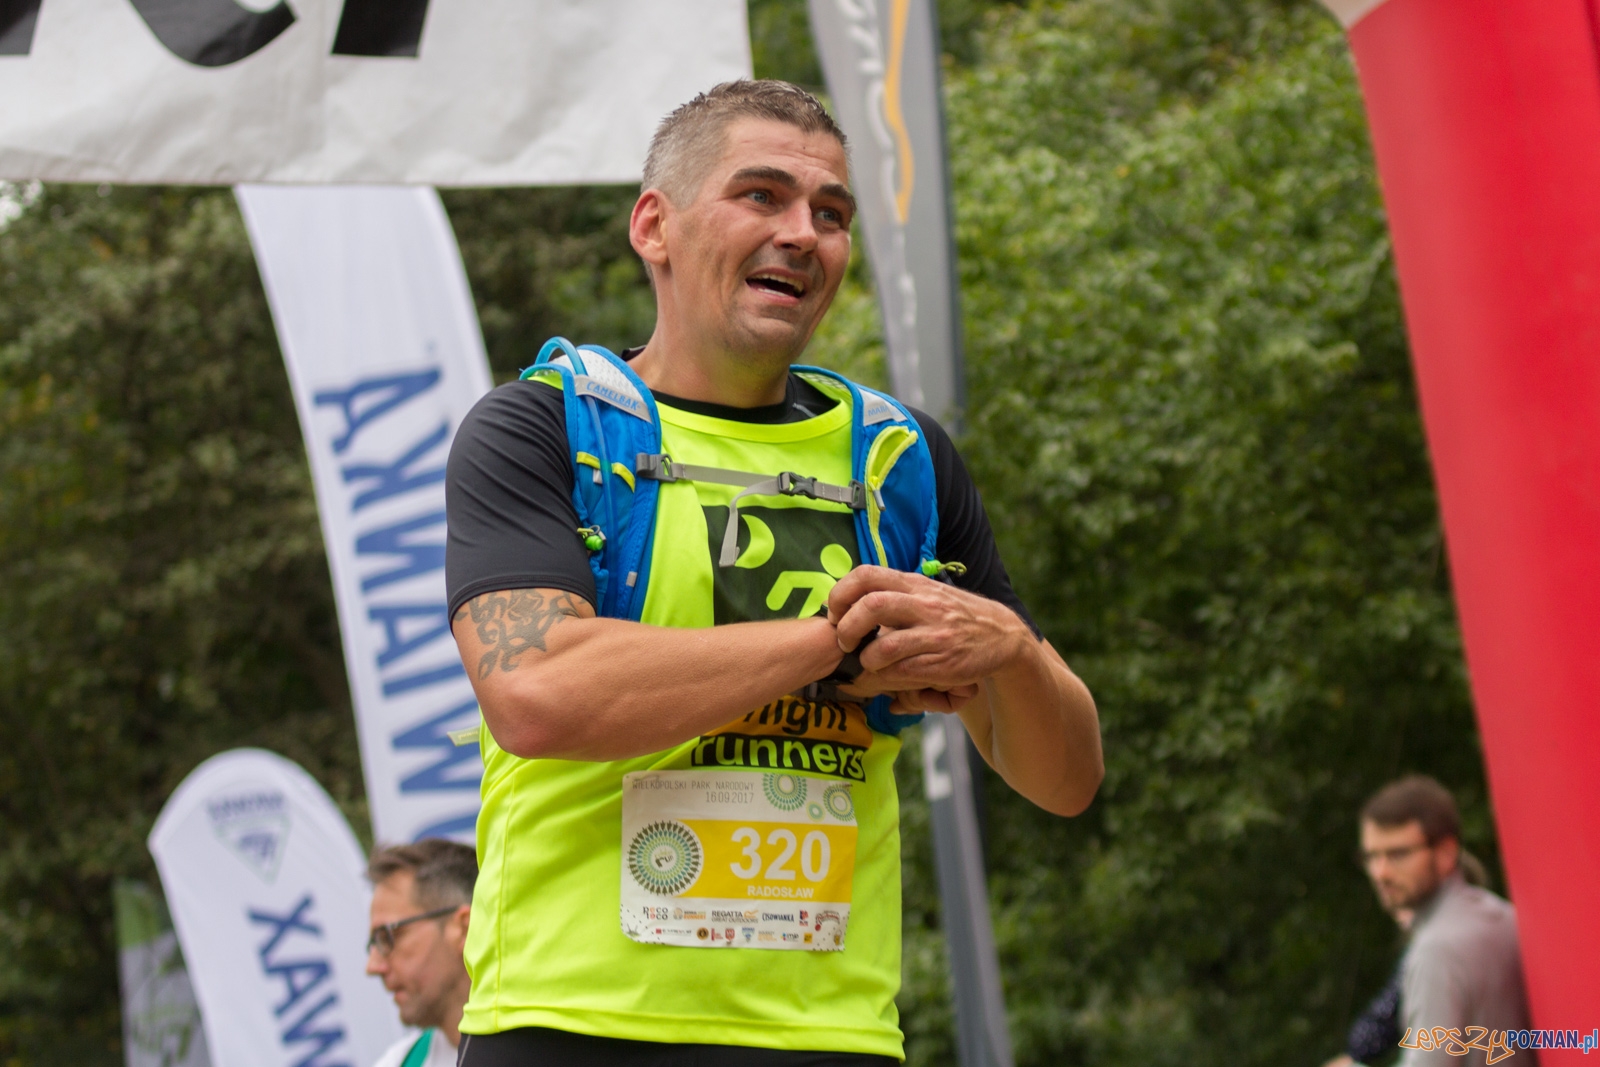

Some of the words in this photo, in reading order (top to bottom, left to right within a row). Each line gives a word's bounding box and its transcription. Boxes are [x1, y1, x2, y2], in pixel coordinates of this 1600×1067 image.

[586, 380, 639, 411] CAMELBAK
[693, 735, 865, 780] runners
[632, 779, 687, 790] WIELKOPOLSKI
[691, 780, 711, 790] PARK
[715, 780, 755, 791] NARODOWY
[729, 826, 832, 882] 320
[747, 884, 815, 899] RADOSŁAW
[711, 909, 743, 918] REGATTA
